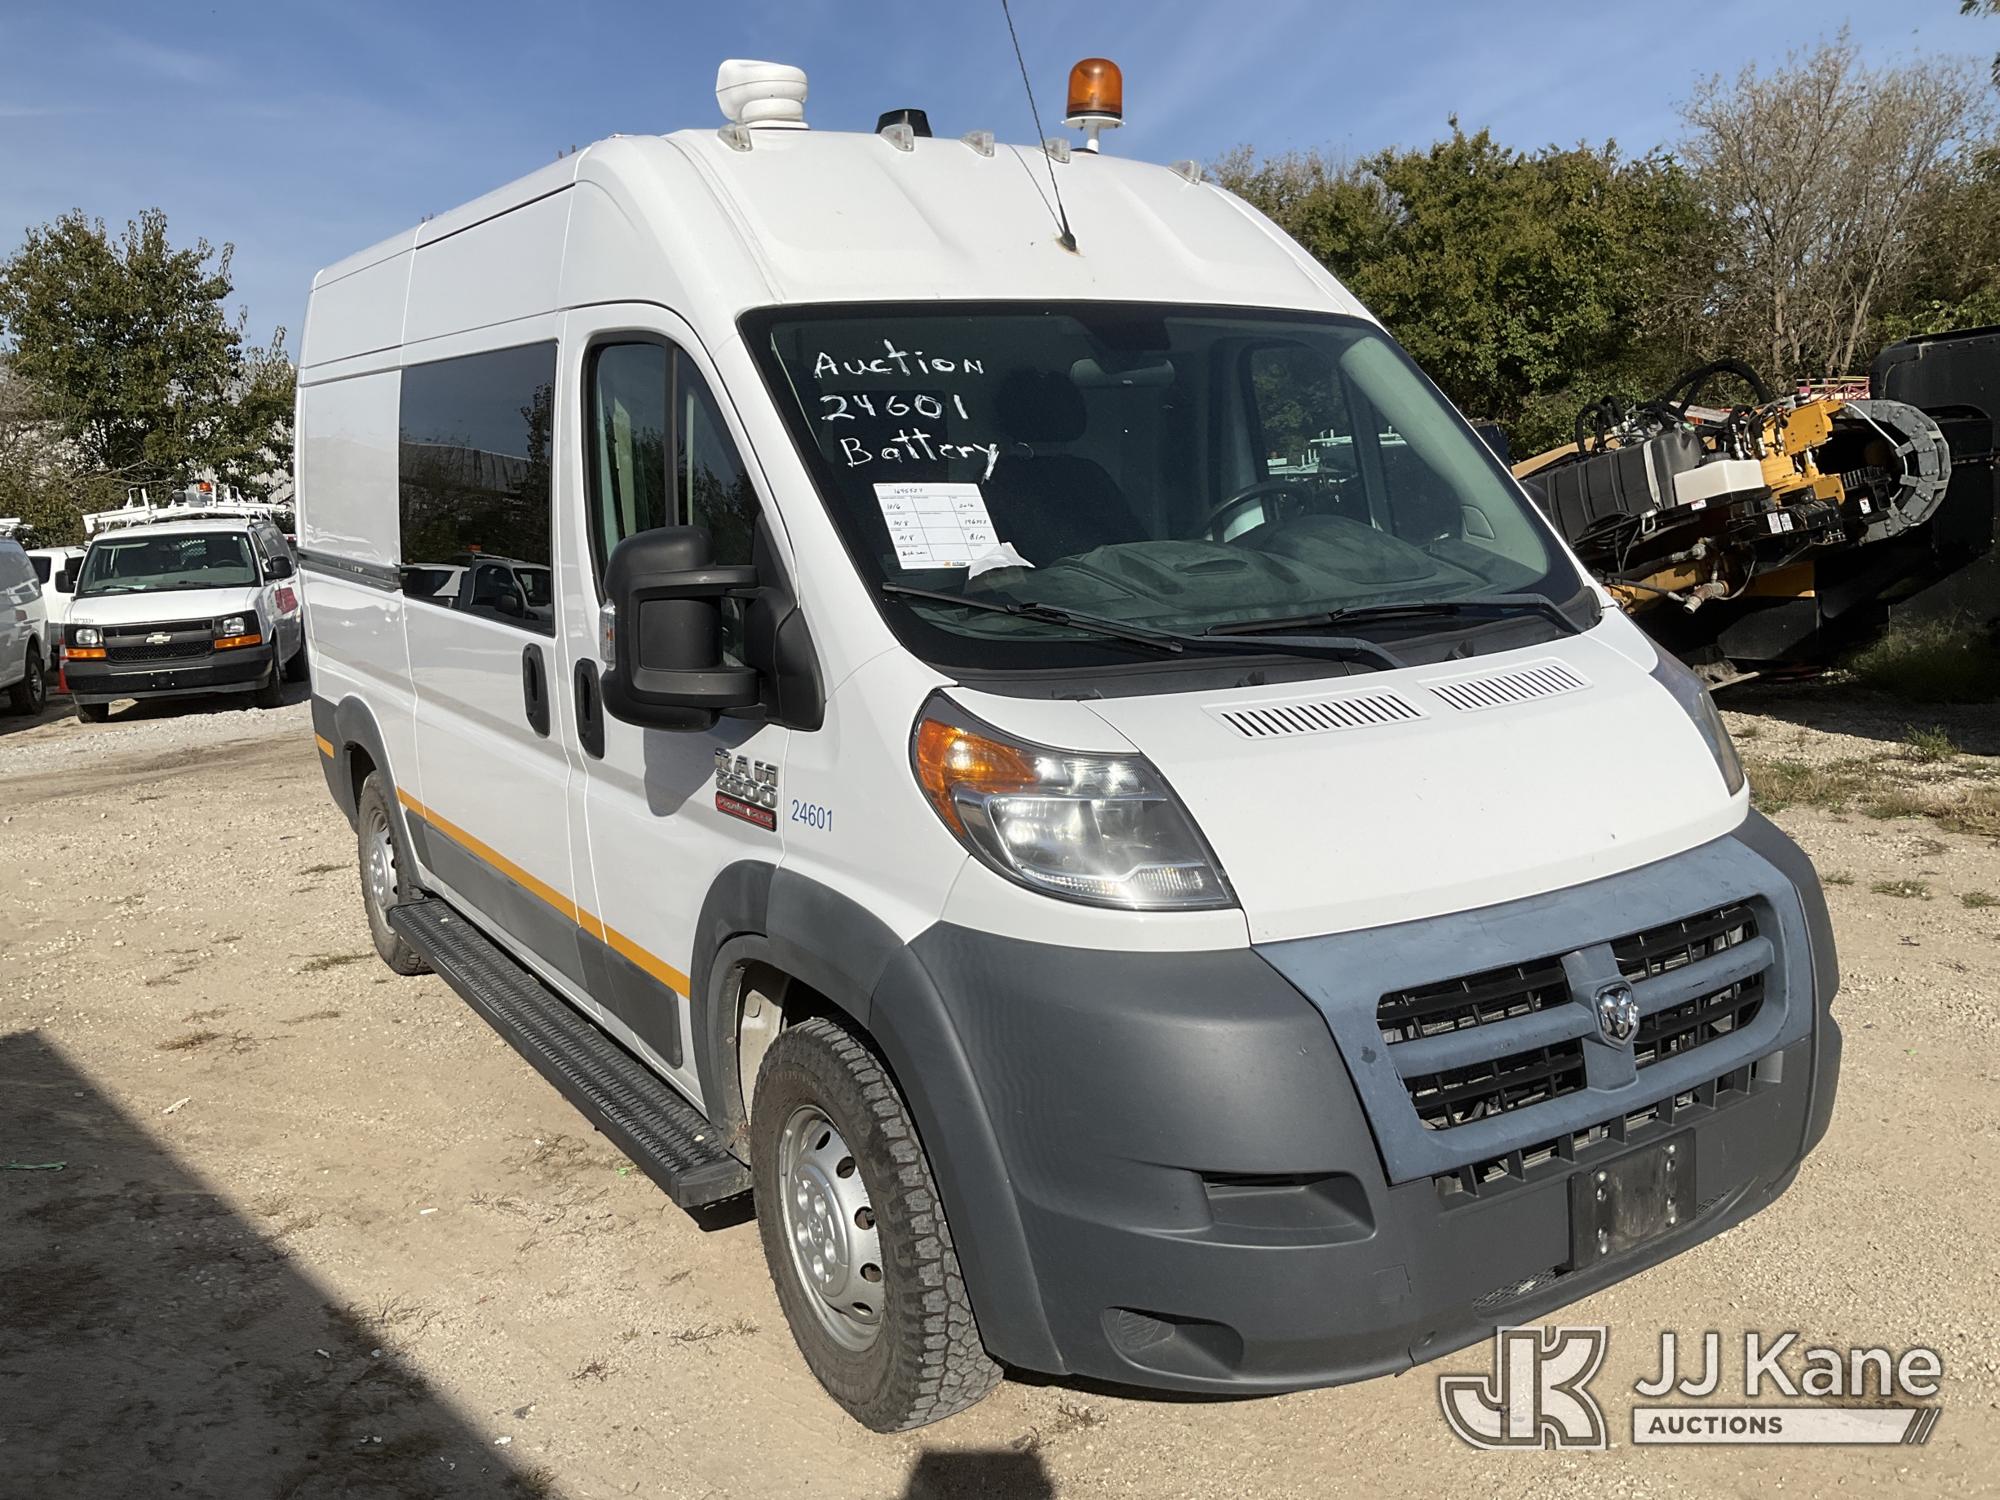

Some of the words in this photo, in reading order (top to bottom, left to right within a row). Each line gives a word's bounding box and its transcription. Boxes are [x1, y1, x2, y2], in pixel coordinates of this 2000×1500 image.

[819, 394, 969, 420] 24601
[839, 428, 1000, 484] Battery
[714, 747, 779, 787] RAM
[791, 799, 833, 832] 24601
